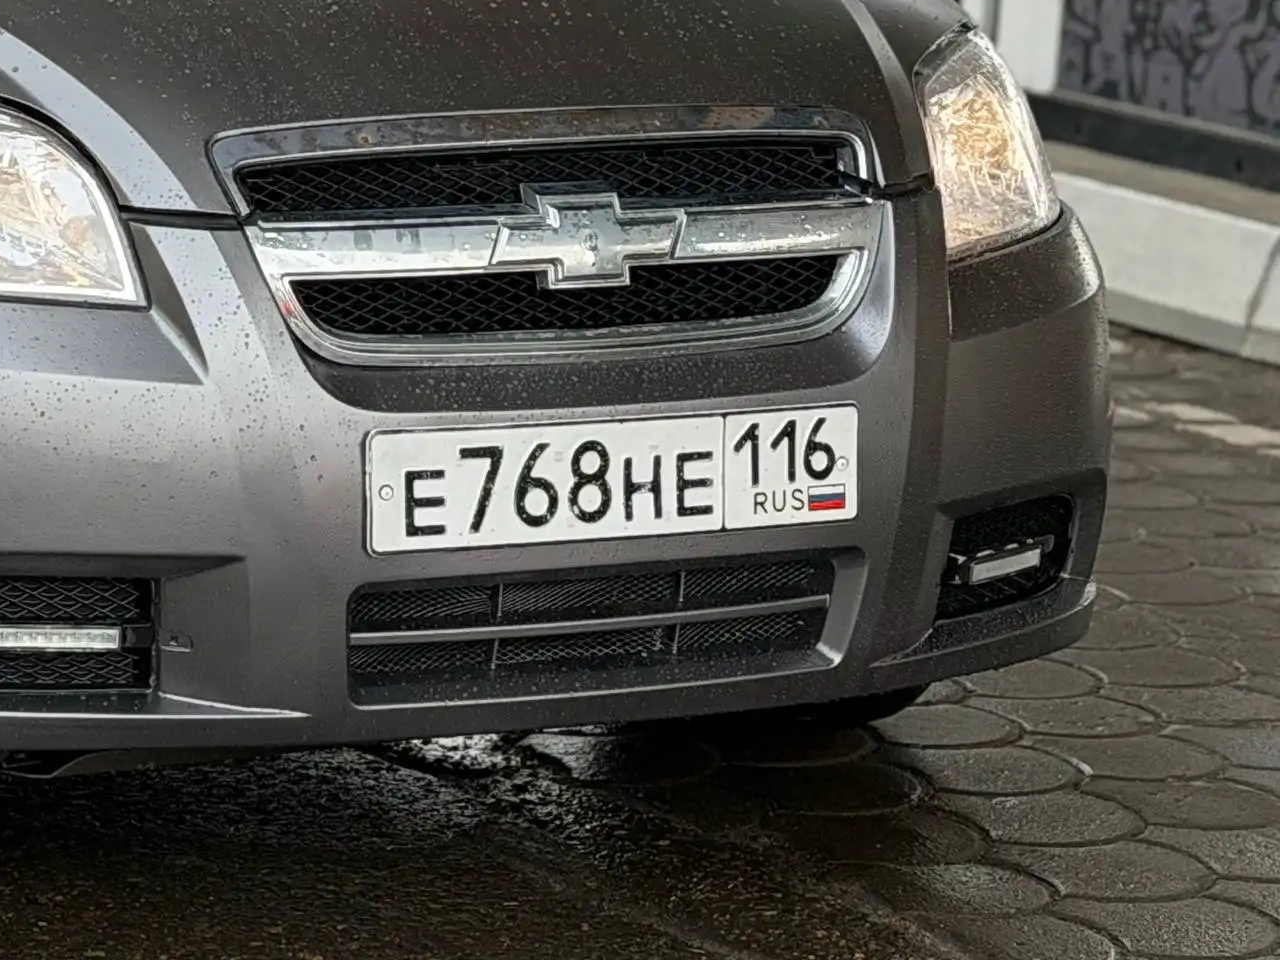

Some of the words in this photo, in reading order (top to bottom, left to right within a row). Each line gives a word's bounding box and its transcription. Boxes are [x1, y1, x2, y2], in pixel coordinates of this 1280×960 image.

[404, 440, 714, 537] E768HE
[733, 416, 836, 487] 116
[753, 488, 806, 515] RUS
